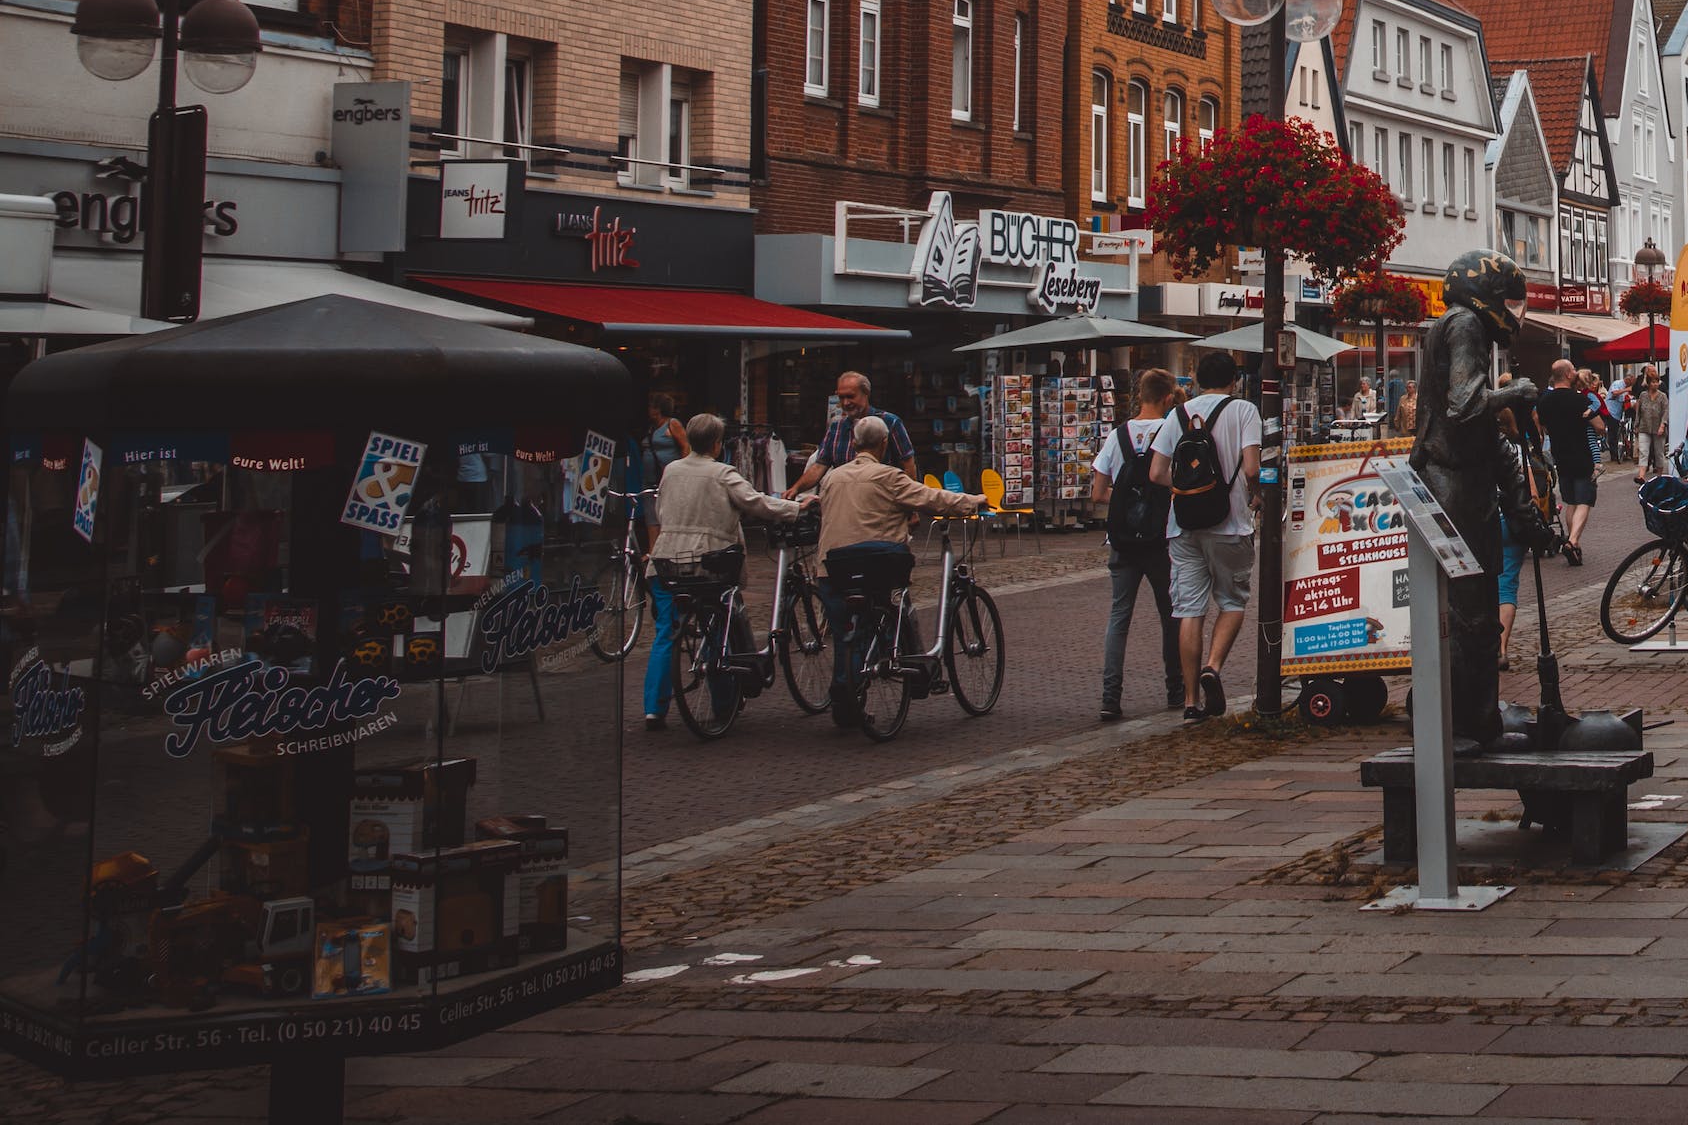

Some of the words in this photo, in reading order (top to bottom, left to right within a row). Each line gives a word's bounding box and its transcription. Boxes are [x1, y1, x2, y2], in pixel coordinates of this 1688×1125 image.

[334, 105, 401, 125] engbers
[444, 189, 469, 199] JEANS
[464, 184, 505, 217] fritz
[53, 191, 237, 244] engrs
[584, 205, 640, 273] fritz
[991, 212, 1077, 263] BÜCHER
[1040, 262, 1101, 309] Leseberg
[1560, 295, 1585, 303] VATTER
[123, 450, 154, 463] Hier
[160, 447, 178, 459] ist
[369, 436, 420, 463] SPIEL
[458, 442, 476, 456] Hier
[477, 441, 489, 453] ist
[515, 449, 533, 462] eure
[535, 450, 556, 463] Welt!
[586, 434, 614, 458] SPIEL
[232, 456, 265, 470] eure
[268, 457, 305, 471] Welt!
[575, 495, 604, 519] SPASS
[1355, 489, 1398, 509] CAS
[346, 502, 401, 530] SPASS
[1319, 510, 1408, 535] MEXICA
[1322, 543, 1347, 556] BAR,
[1339, 547, 1407, 566] STEAKHOUSE
[472, 568, 524, 611] PIELWAREN
[1295, 574, 1348, 591] Mittags-
[1304, 587, 1342, 601] aktion
[1294, 601, 1329, 616] 12-14
[1332, 596, 1354, 608] Uhr
[481, 575, 606, 675] Fleischer
[142, 648, 242, 700] SPIELWAREN
[165, 656, 401, 758] Fleischer
[276, 711, 398, 756] SCHREIBWAREN
[439, 1003, 474, 1025] Celler
[476, 996, 497, 1013] Str.
[499, 986, 515, 1006] 56
[521, 977, 541, 997] Tel.
[542, 973, 554, 993] (0
[555, 967, 570, 987] 50
[569, 960, 588, 981] 21)
[588, 956, 602, 973] 40
[603, 951, 617, 969] 45
[86, 1038, 149, 1059] Celler
[154, 1033, 191, 1052] Str.
[196, 1028, 223, 1047] 56
[238, 1026, 272, 1045] Tel.
[278, 1021, 297, 1042] (0
[303, 1019, 327, 1039] 50
[331, 1016, 364, 1037] 21)
[368, 1014, 393, 1034] 40
[397, 1012, 423, 1032] 45
